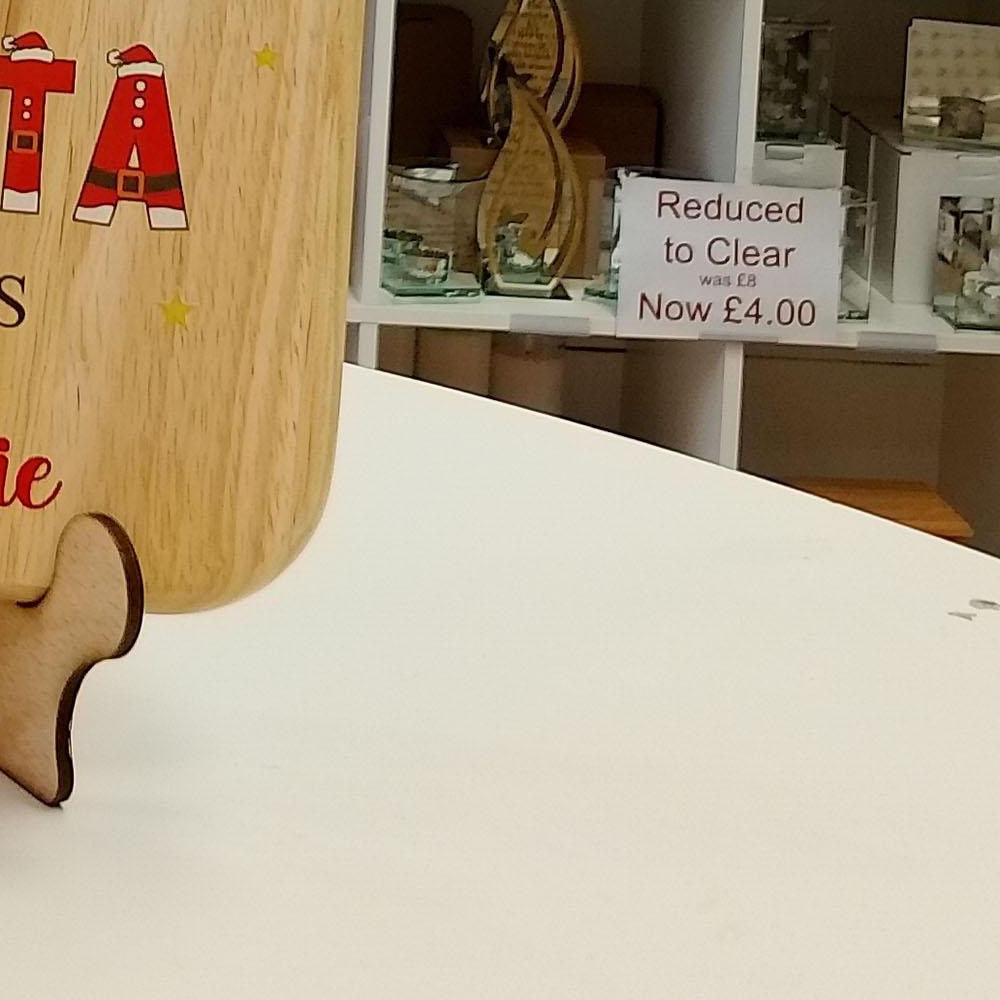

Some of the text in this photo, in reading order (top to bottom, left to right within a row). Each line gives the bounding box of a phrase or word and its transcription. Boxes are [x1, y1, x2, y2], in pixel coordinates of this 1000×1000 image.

[656, 190, 804, 224] Reduced
[663, 236, 796, 268] to Clear
[699, 273, 757, 288] was £8
[638, 293, 817, 327] Now £4.00
